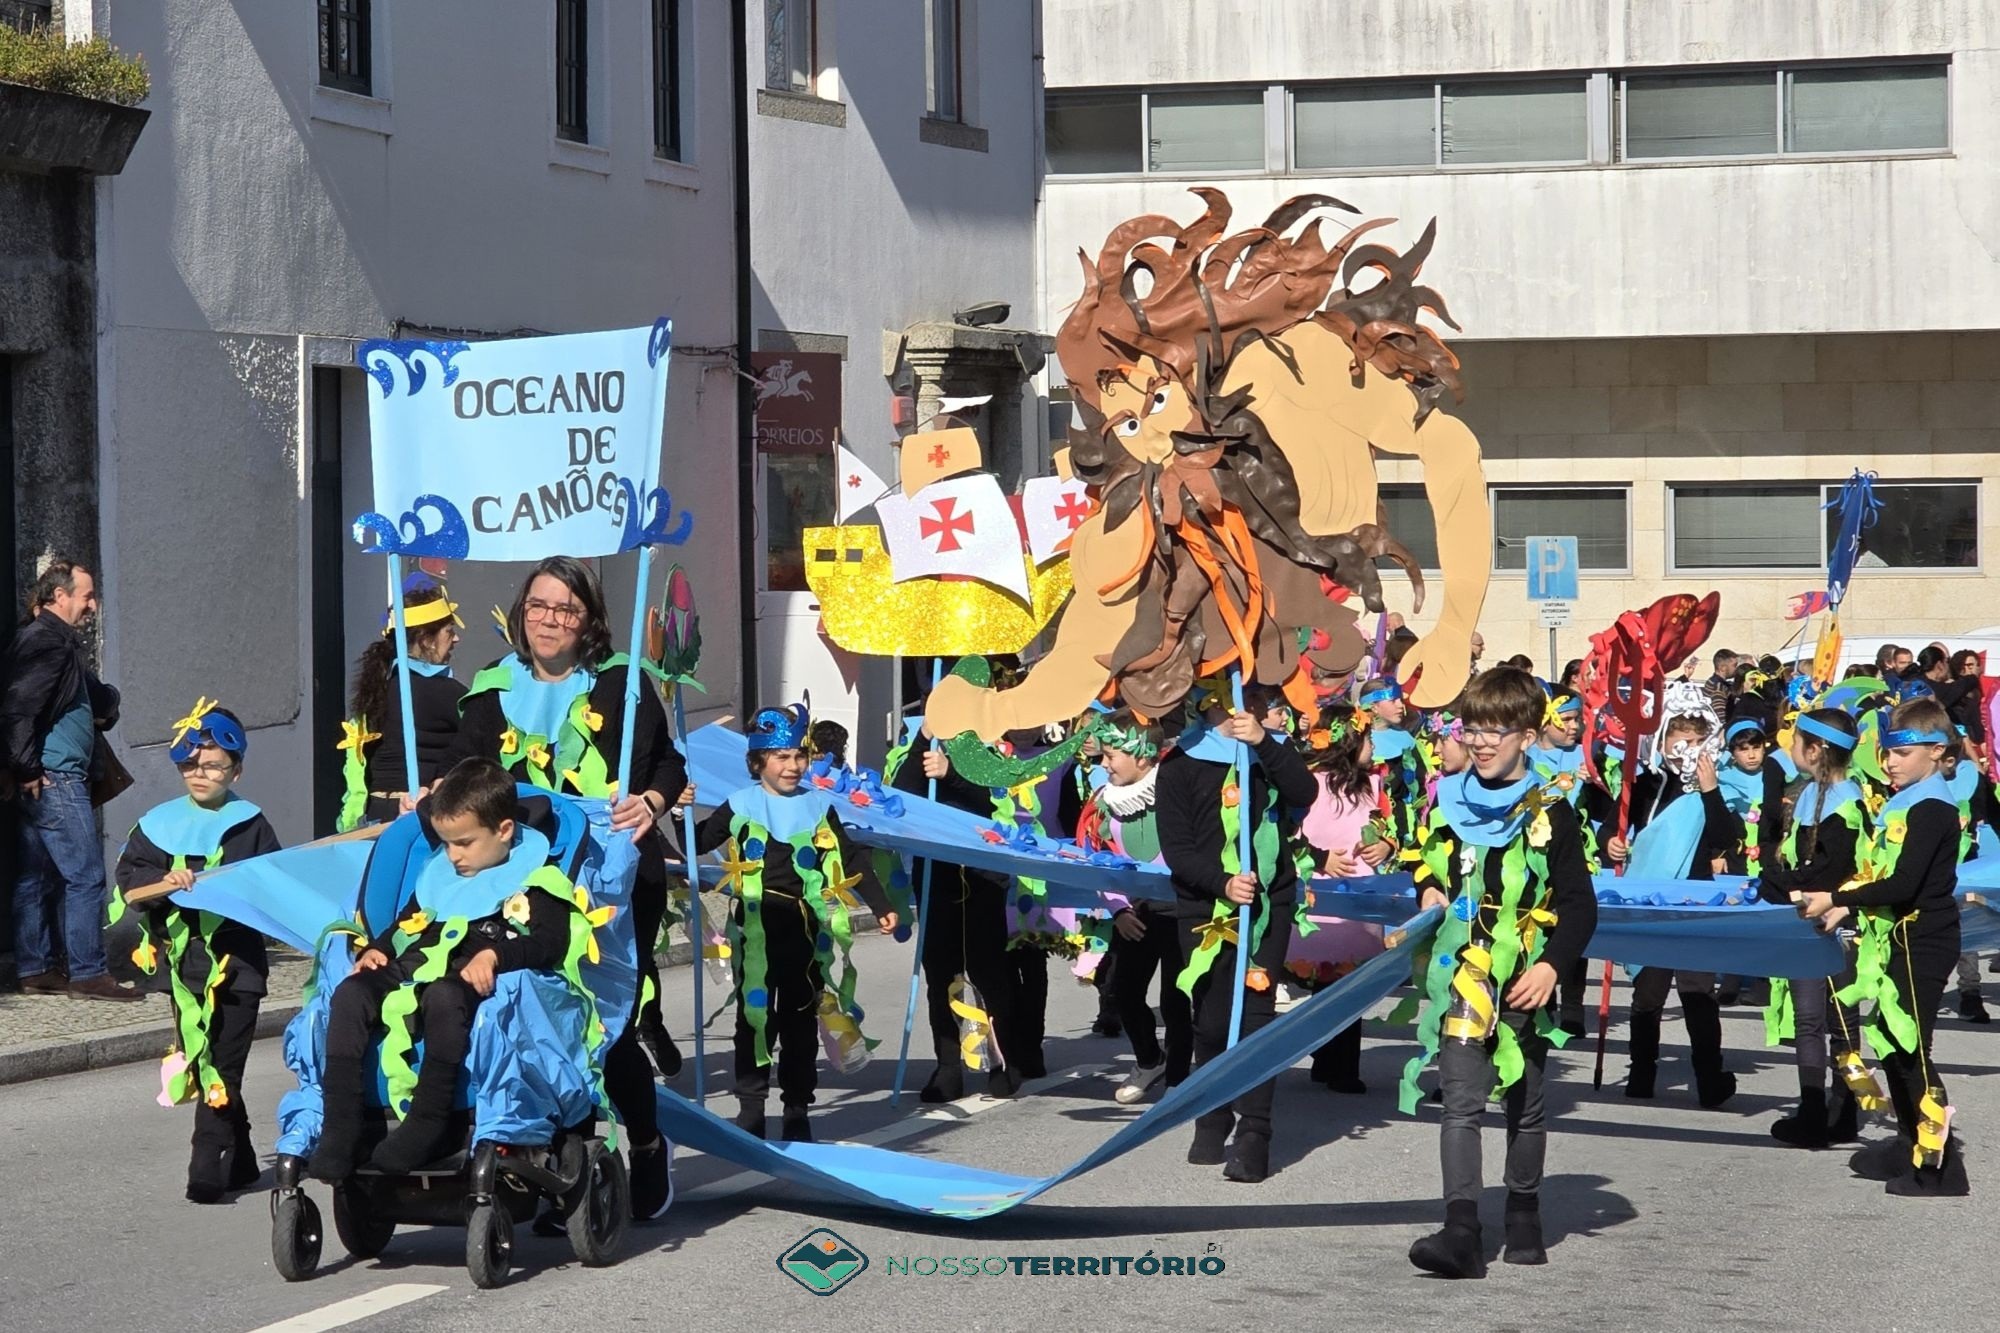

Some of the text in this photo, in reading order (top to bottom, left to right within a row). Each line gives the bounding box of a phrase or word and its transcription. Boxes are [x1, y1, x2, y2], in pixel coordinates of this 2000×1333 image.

[453, 370, 625, 419] OCEANO
[566, 425, 617, 466] DE
[758, 427, 824, 446] ORREIOS
[471, 466, 628, 534] CAMÕES
[1538, 543, 1567, 594] P
